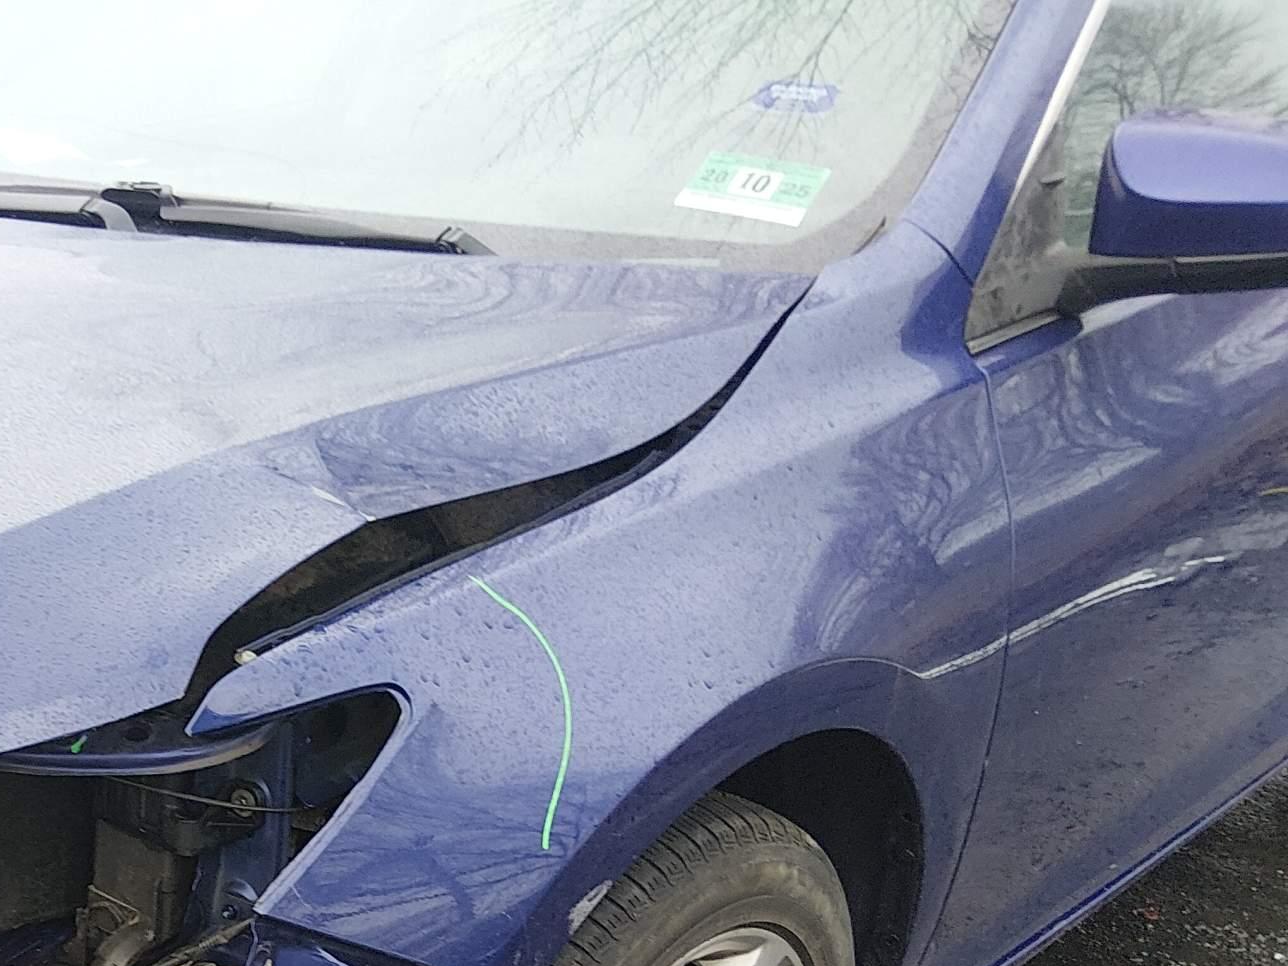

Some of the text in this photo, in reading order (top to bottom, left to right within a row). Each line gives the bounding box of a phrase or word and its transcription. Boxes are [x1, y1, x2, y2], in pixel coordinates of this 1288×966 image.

[699, 167, 729, 184] 20
[740, 172, 772, 194] 10
[778, 182, 812, 199] 25
